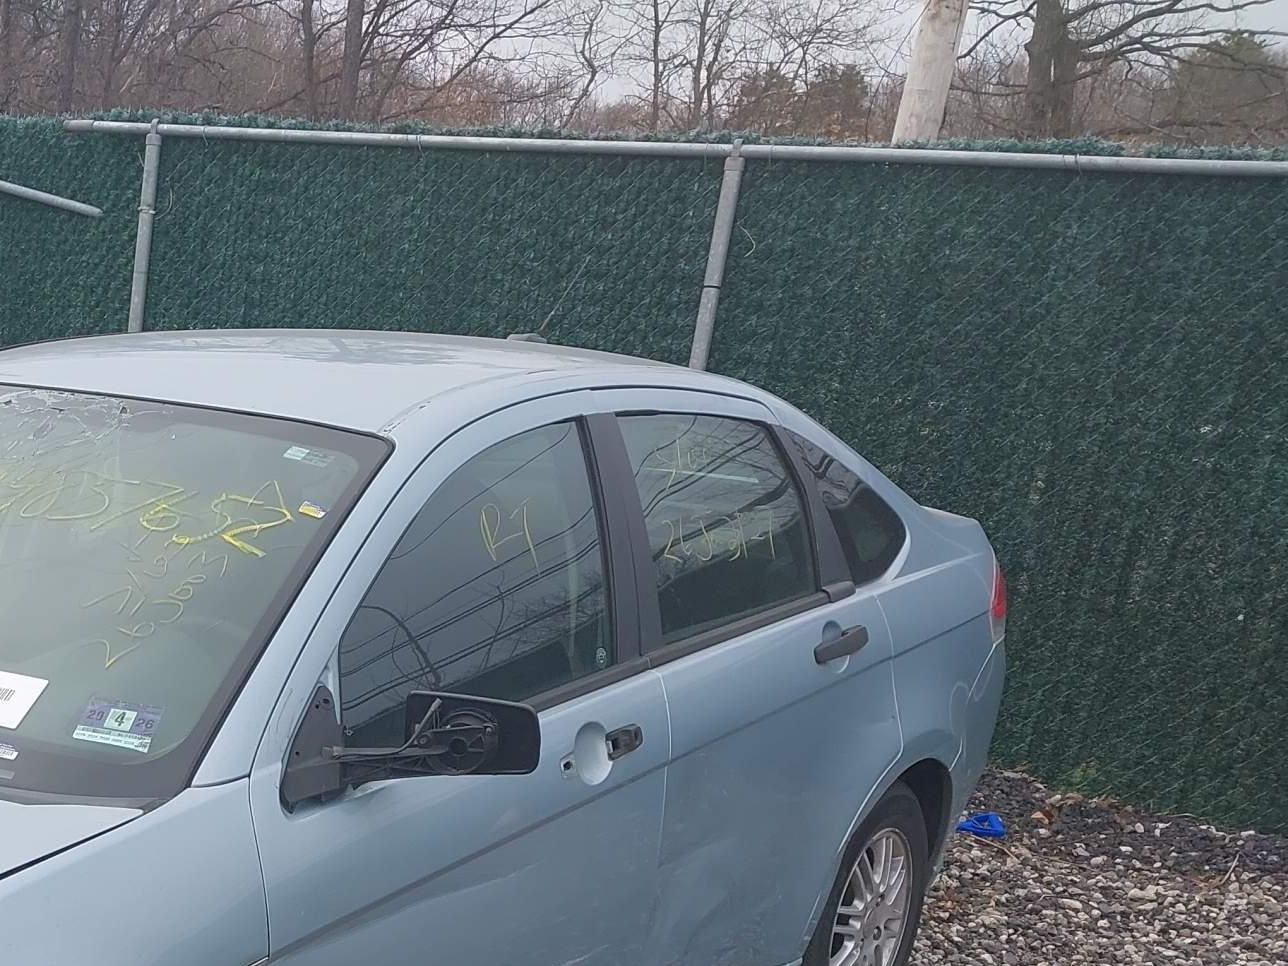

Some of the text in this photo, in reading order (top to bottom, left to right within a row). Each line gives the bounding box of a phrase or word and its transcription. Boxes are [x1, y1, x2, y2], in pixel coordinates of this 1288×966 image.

[86, 709, 155, 729] 20 4 26
